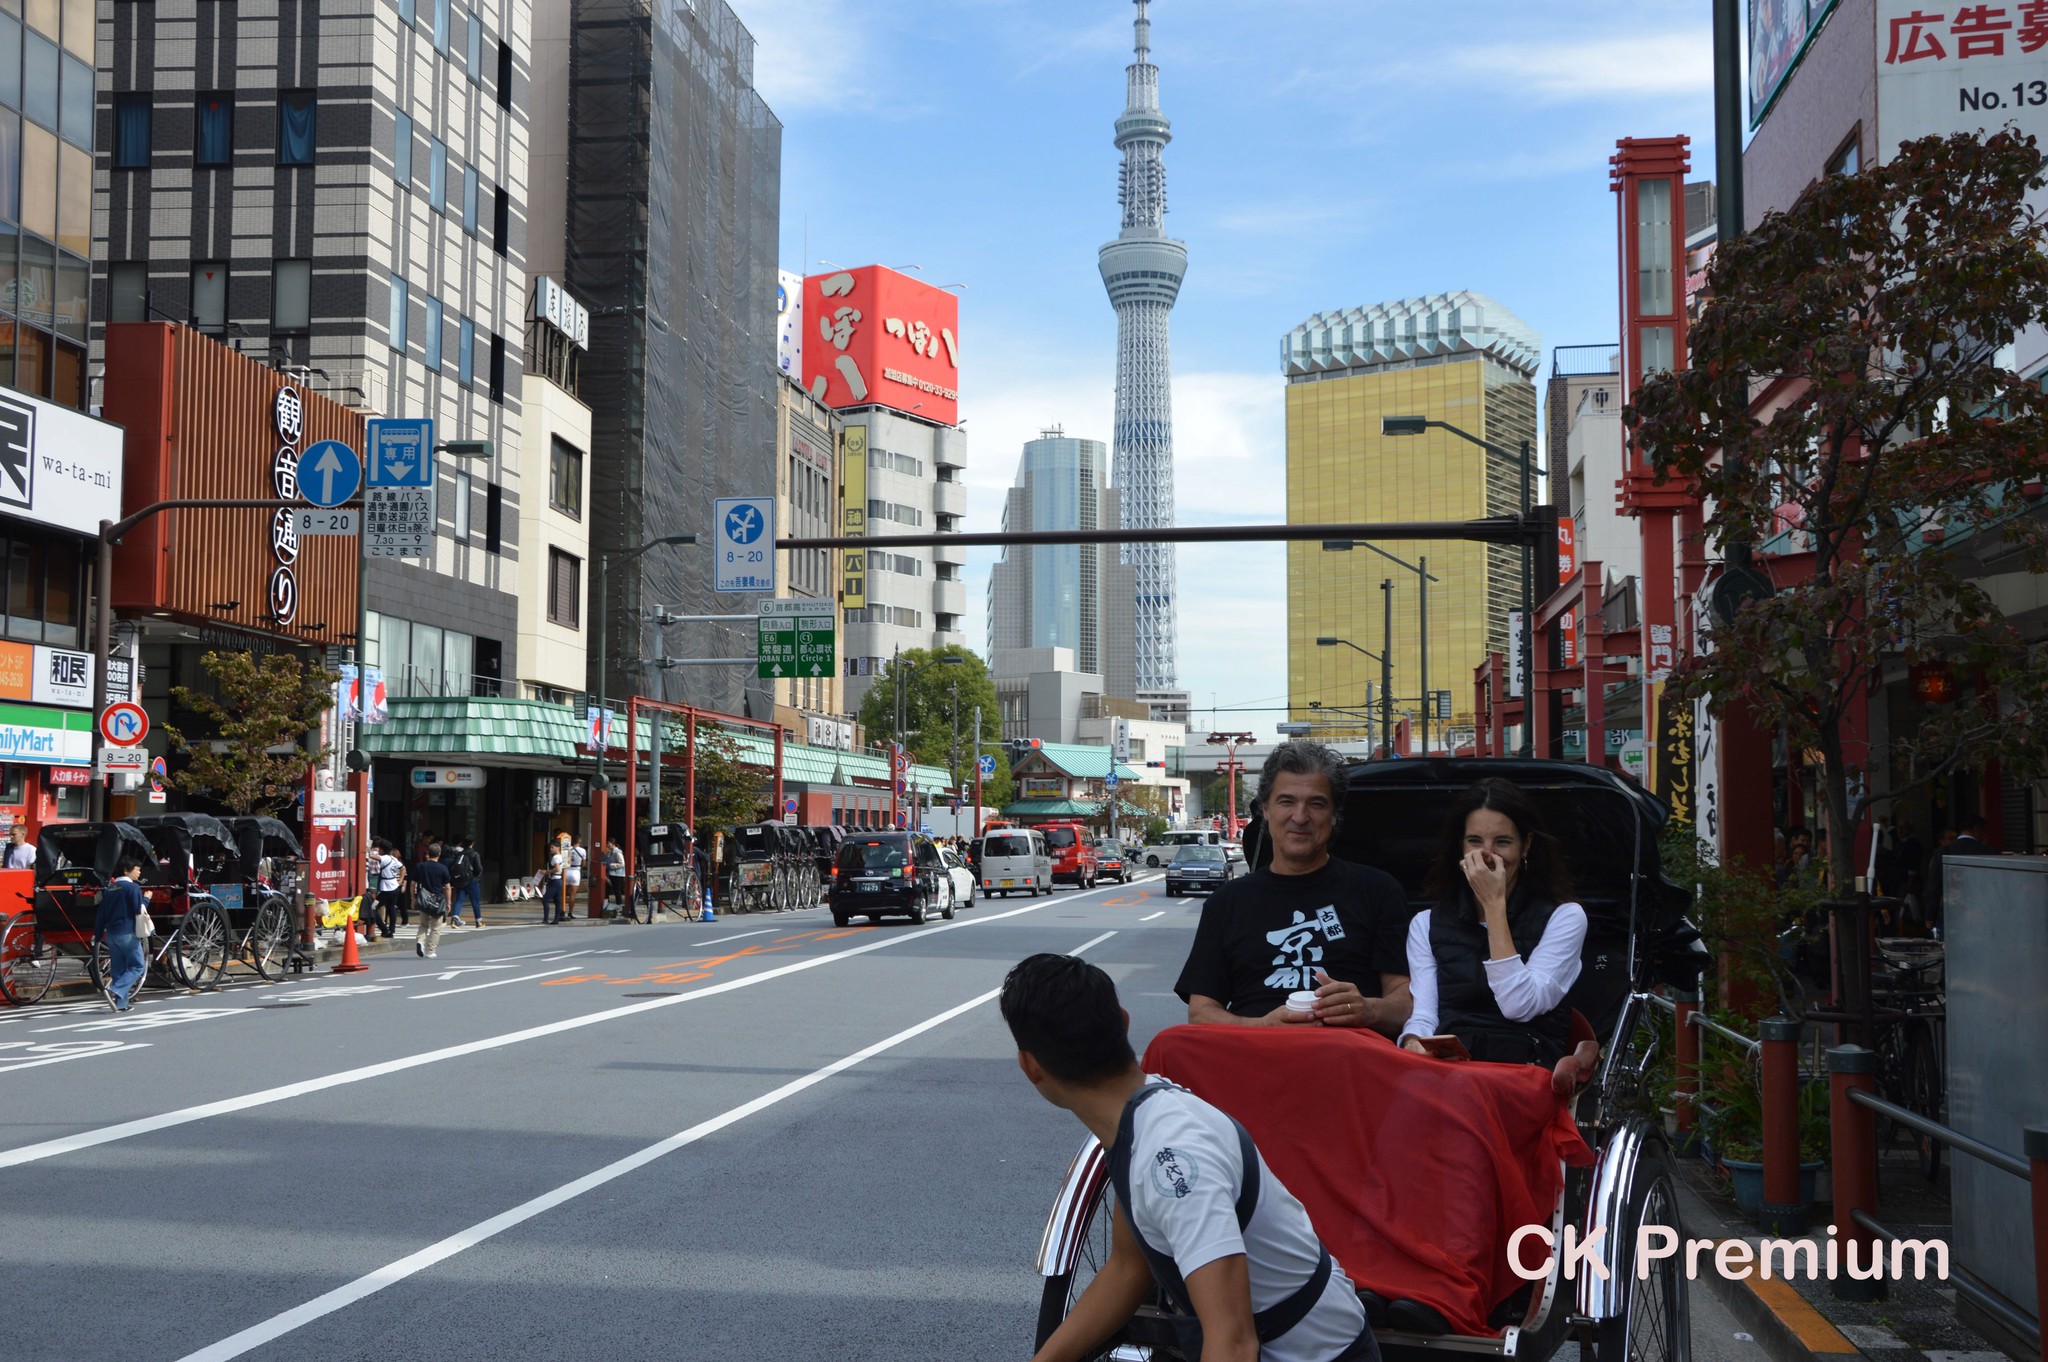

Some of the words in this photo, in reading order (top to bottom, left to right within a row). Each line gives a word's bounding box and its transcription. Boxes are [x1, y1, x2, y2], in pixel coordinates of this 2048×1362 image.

[885, 317, 958, 368] つぼ八
[384, 446, 416, 460] 専用
[42, 456, 111, 489] wa-ta-mi
[372, 492, 424, 502] 路線バス
[275, 389, 302, 616] 観音通り
[367, 512, 428, 522] 通勤送迎バス
[371, 547, 422, 556] ここまで
[846, 509, 863, 596] 神バー
[764, 603, 770, 612] 6
[776, 603, 800, 612] 首都高
[762, 620, 792, 630] 向島入口
[800, 619, 831, 630] 駒形入口
[764, 634, 775, 642] E6
[799, 644, 832, 654] 都心環状
[759, 655, 781, 663] JOBAN
[52, 654, 86, 685] 和民
[1320, 910, 1342, 938] 古都
[1155, 1146, 1192, 1199] 時代屋
